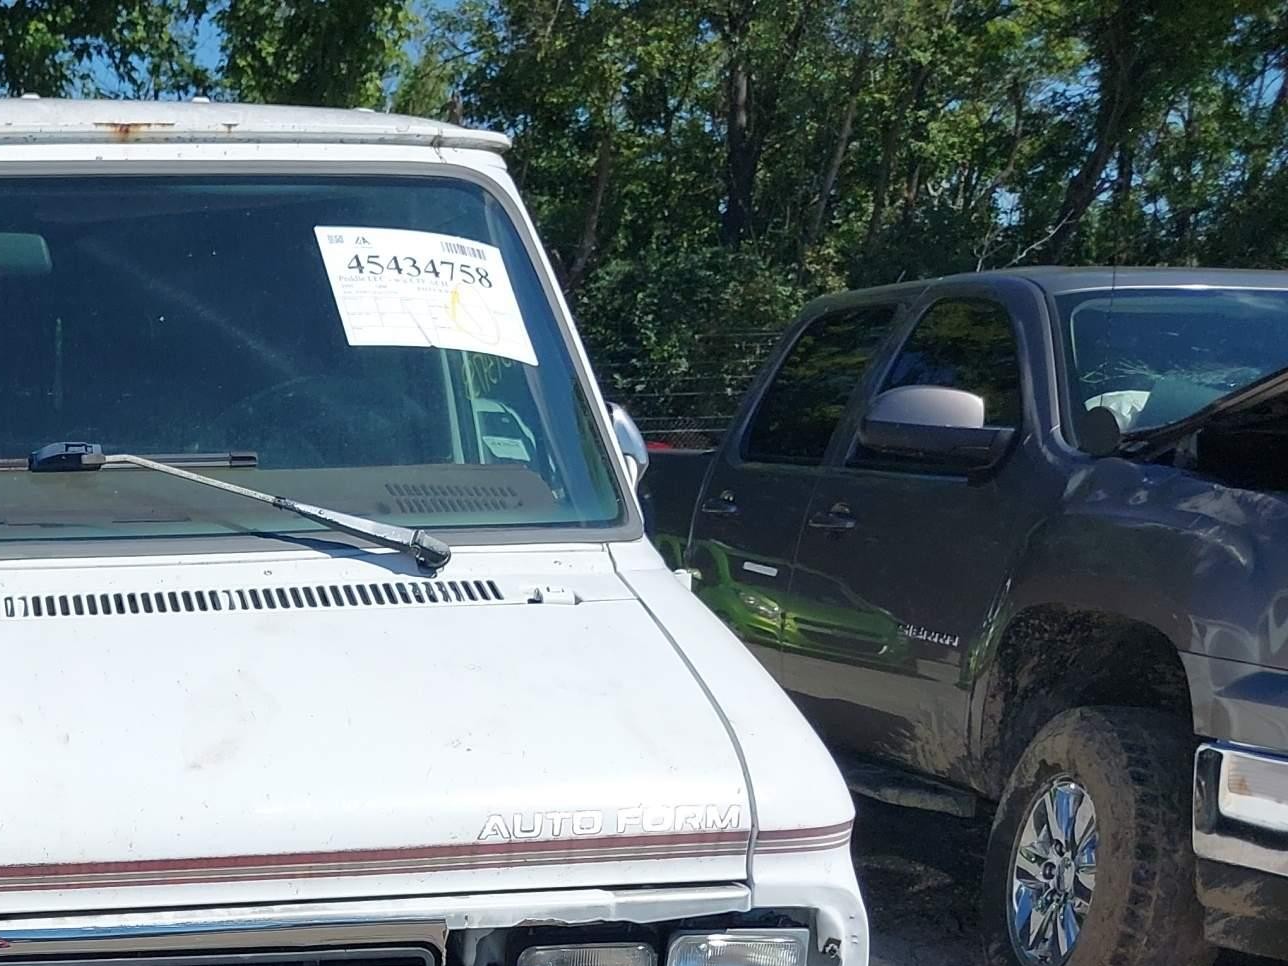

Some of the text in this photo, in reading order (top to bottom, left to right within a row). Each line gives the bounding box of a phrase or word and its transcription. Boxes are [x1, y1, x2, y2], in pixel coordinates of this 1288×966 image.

[347, 253, 494, 289] 45434758
[477, 803, 741, 841] AUTO FORM
